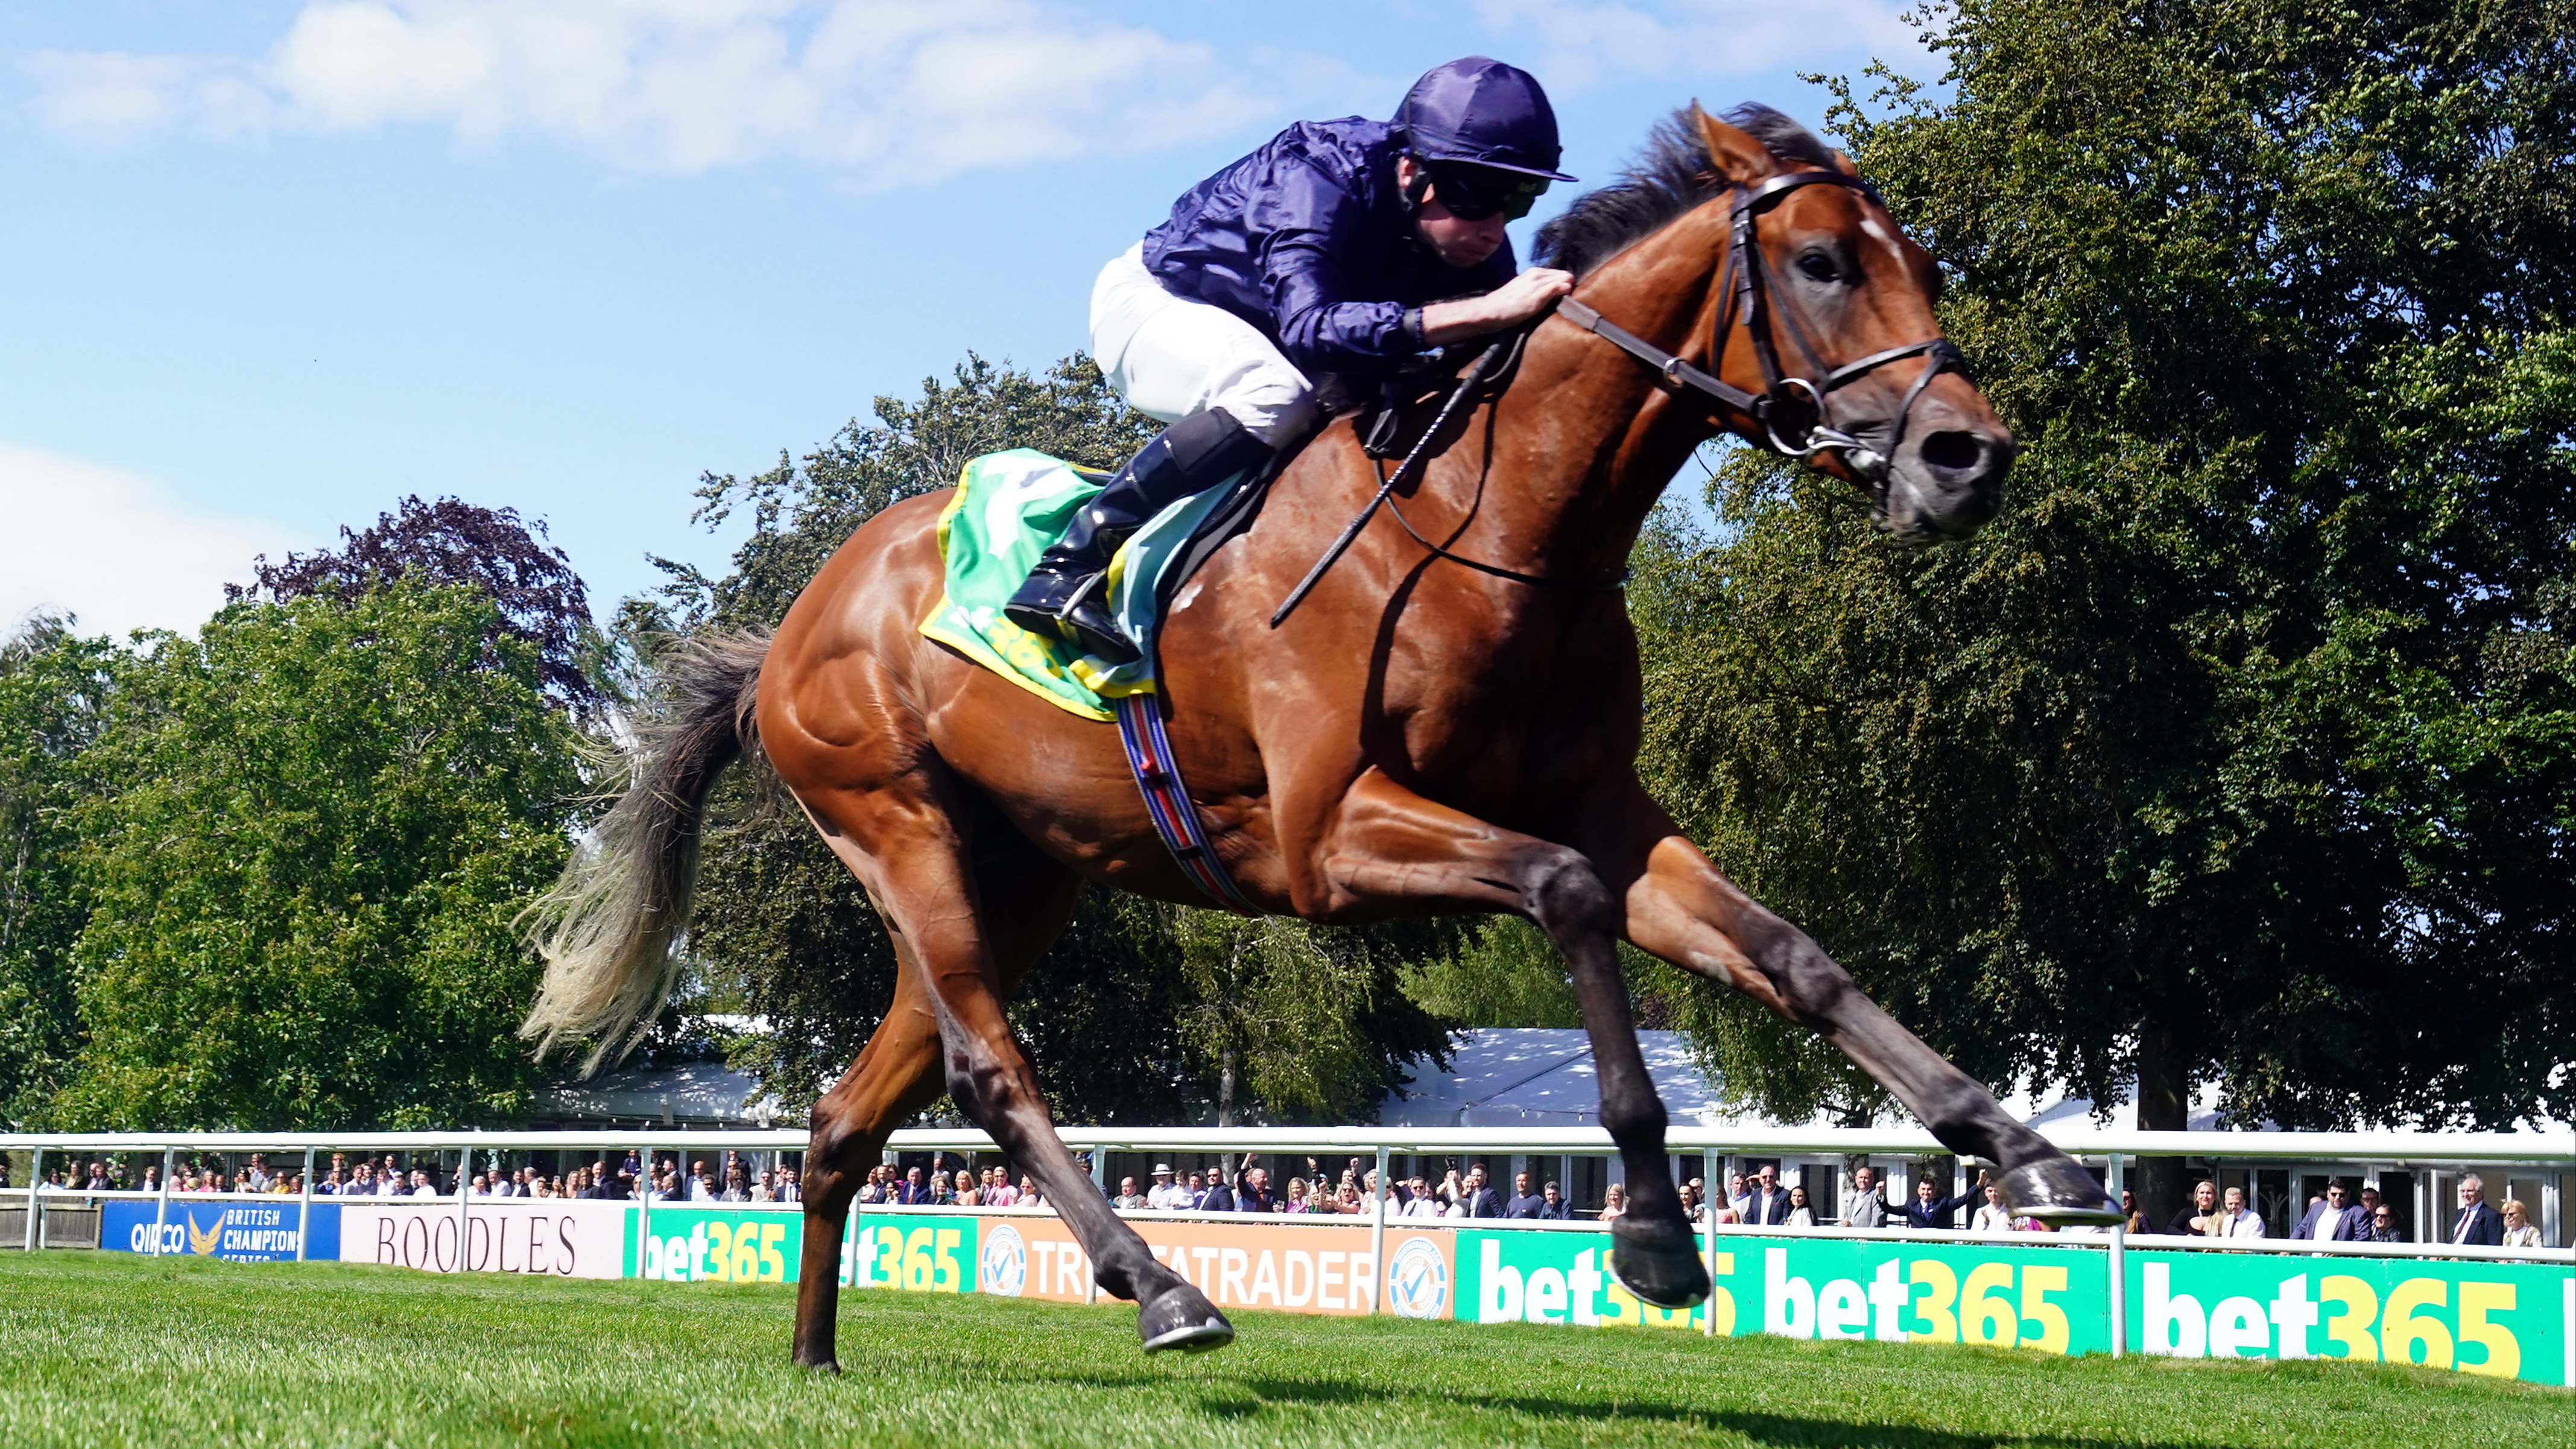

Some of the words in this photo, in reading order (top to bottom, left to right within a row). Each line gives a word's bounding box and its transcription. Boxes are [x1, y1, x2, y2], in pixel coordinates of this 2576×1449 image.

[226, 1209, 280, 1226] BRITISH
[377, 1216, 575, 1275] BOODLES
[636, 1215, 785, 1283] bet365
[799, 1219, 961, 1293] t365
[1031, 1240, 1377, 1310] TRATRADER
[1479, 1238, 1736, 1336] bet35
[1764, 1247, 2070, 1355] bet365
[2142, 1261, 2521, 1379] bet365
